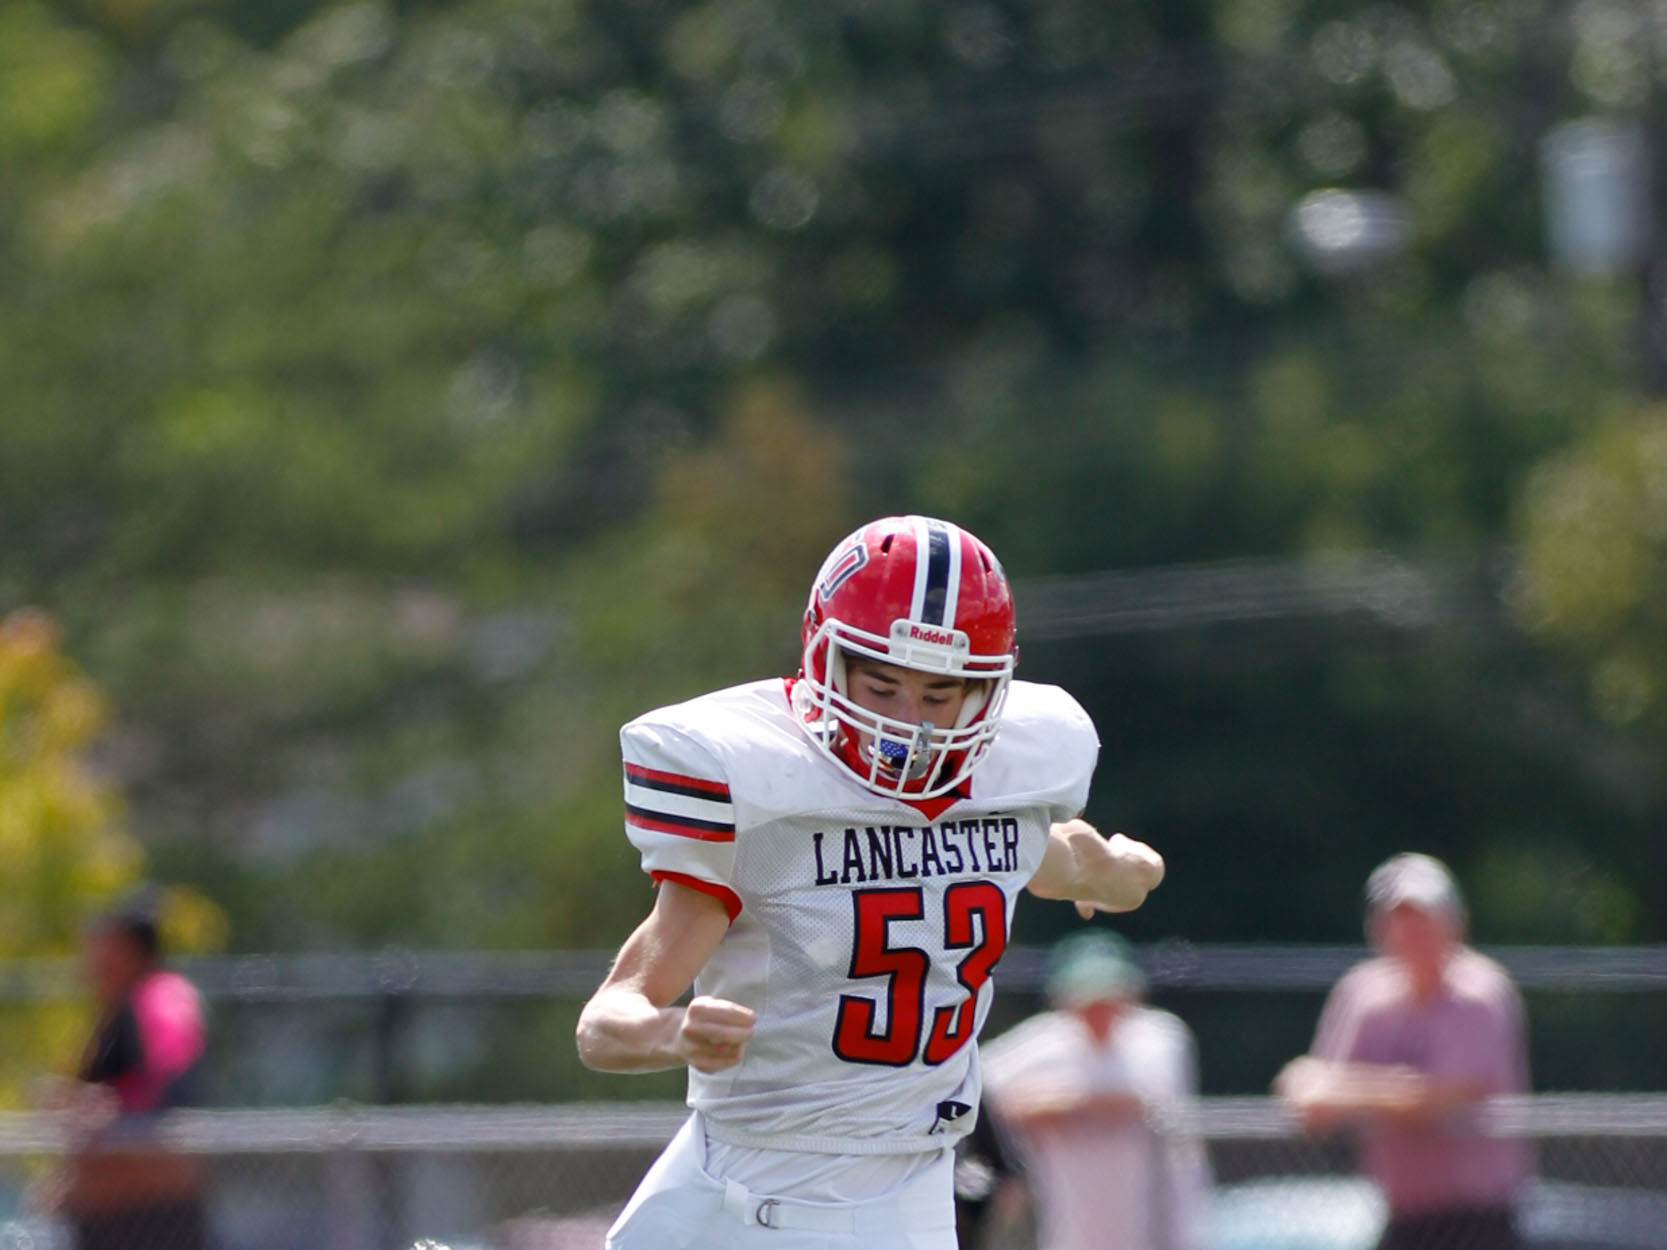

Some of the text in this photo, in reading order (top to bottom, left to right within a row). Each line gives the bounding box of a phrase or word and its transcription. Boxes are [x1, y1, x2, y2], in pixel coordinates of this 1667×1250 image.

[910, 625, 954, 646] Riddell
[813, 817, 1019, 886] LANCASTER
[831, 879, 1007, 1068] 53
